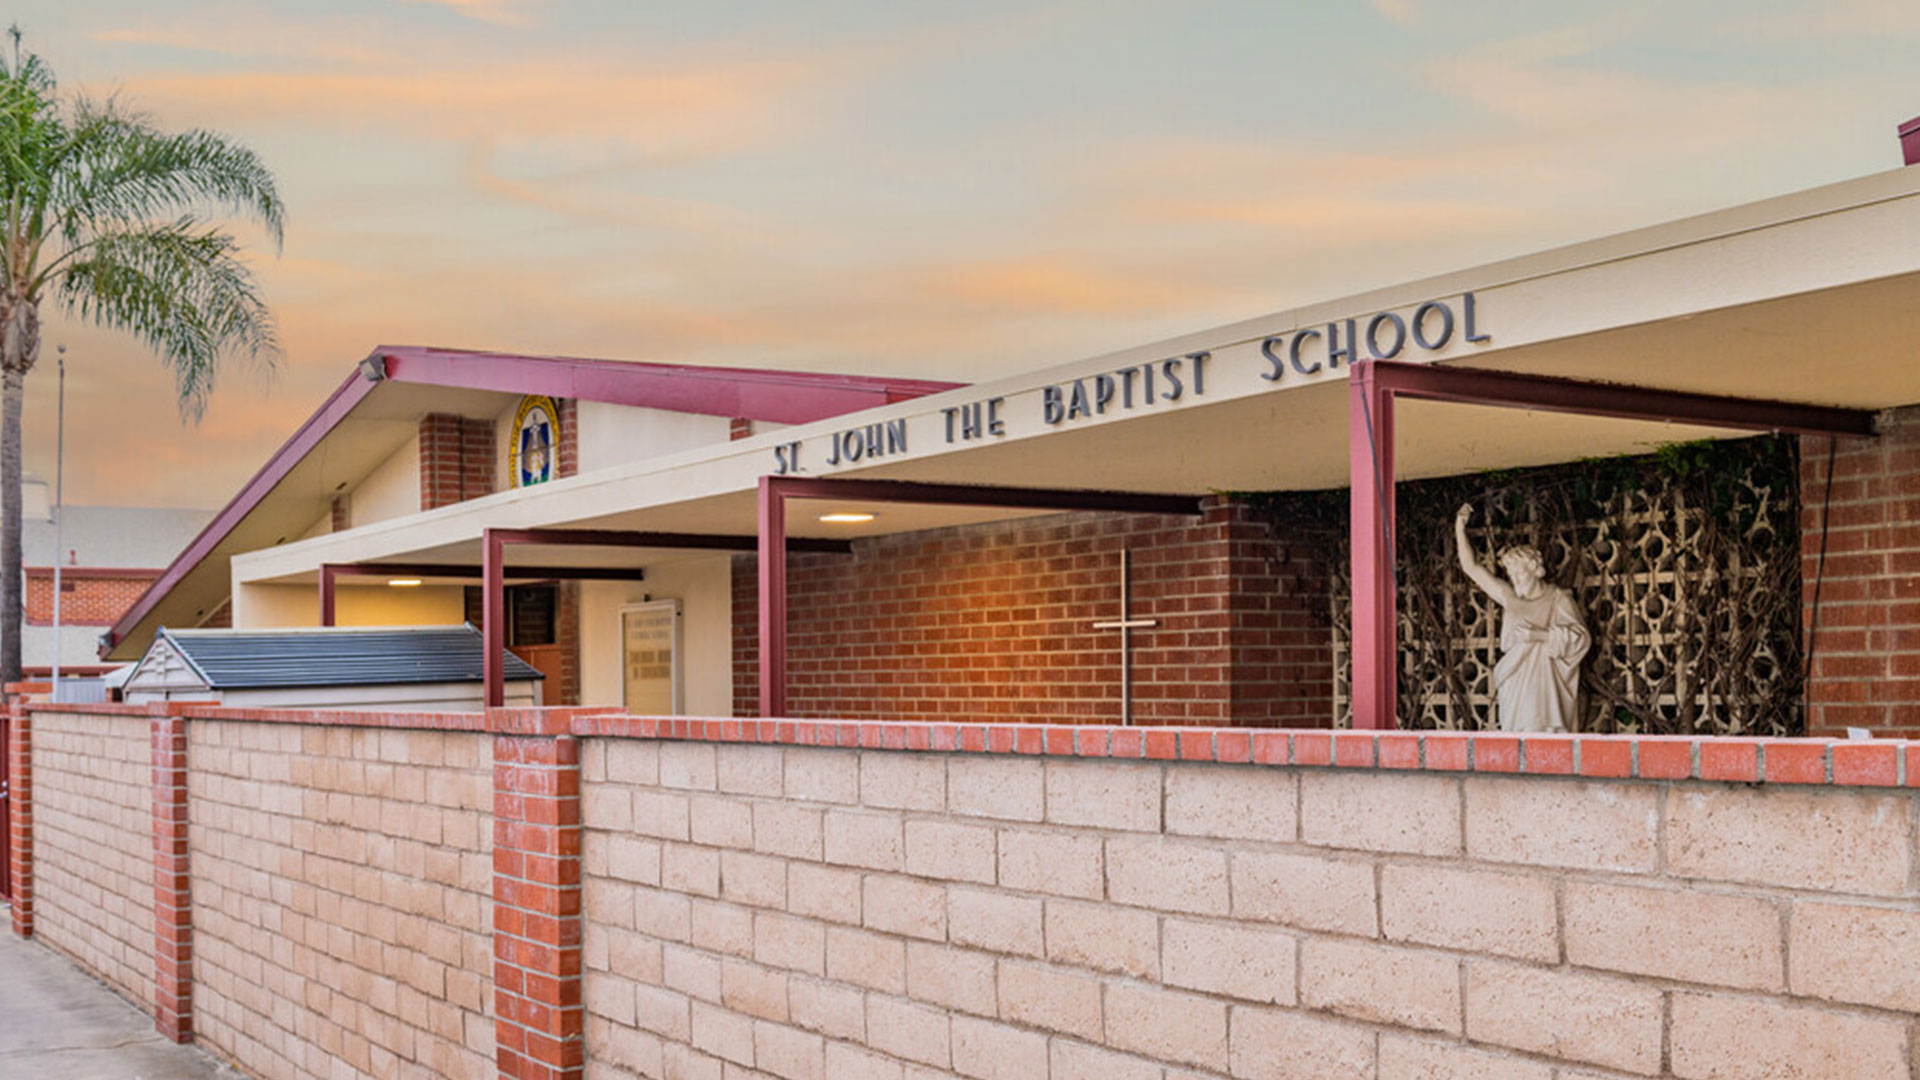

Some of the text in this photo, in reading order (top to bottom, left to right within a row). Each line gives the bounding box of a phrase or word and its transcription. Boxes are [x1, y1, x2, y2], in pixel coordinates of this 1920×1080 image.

[826, 418, 907, 465] JOHN
[941, 399, 1005, 443] THE
[1043, 350, 1212, 425] BAPTIST
[1260, 292, 1492, 381] SCHOOL
